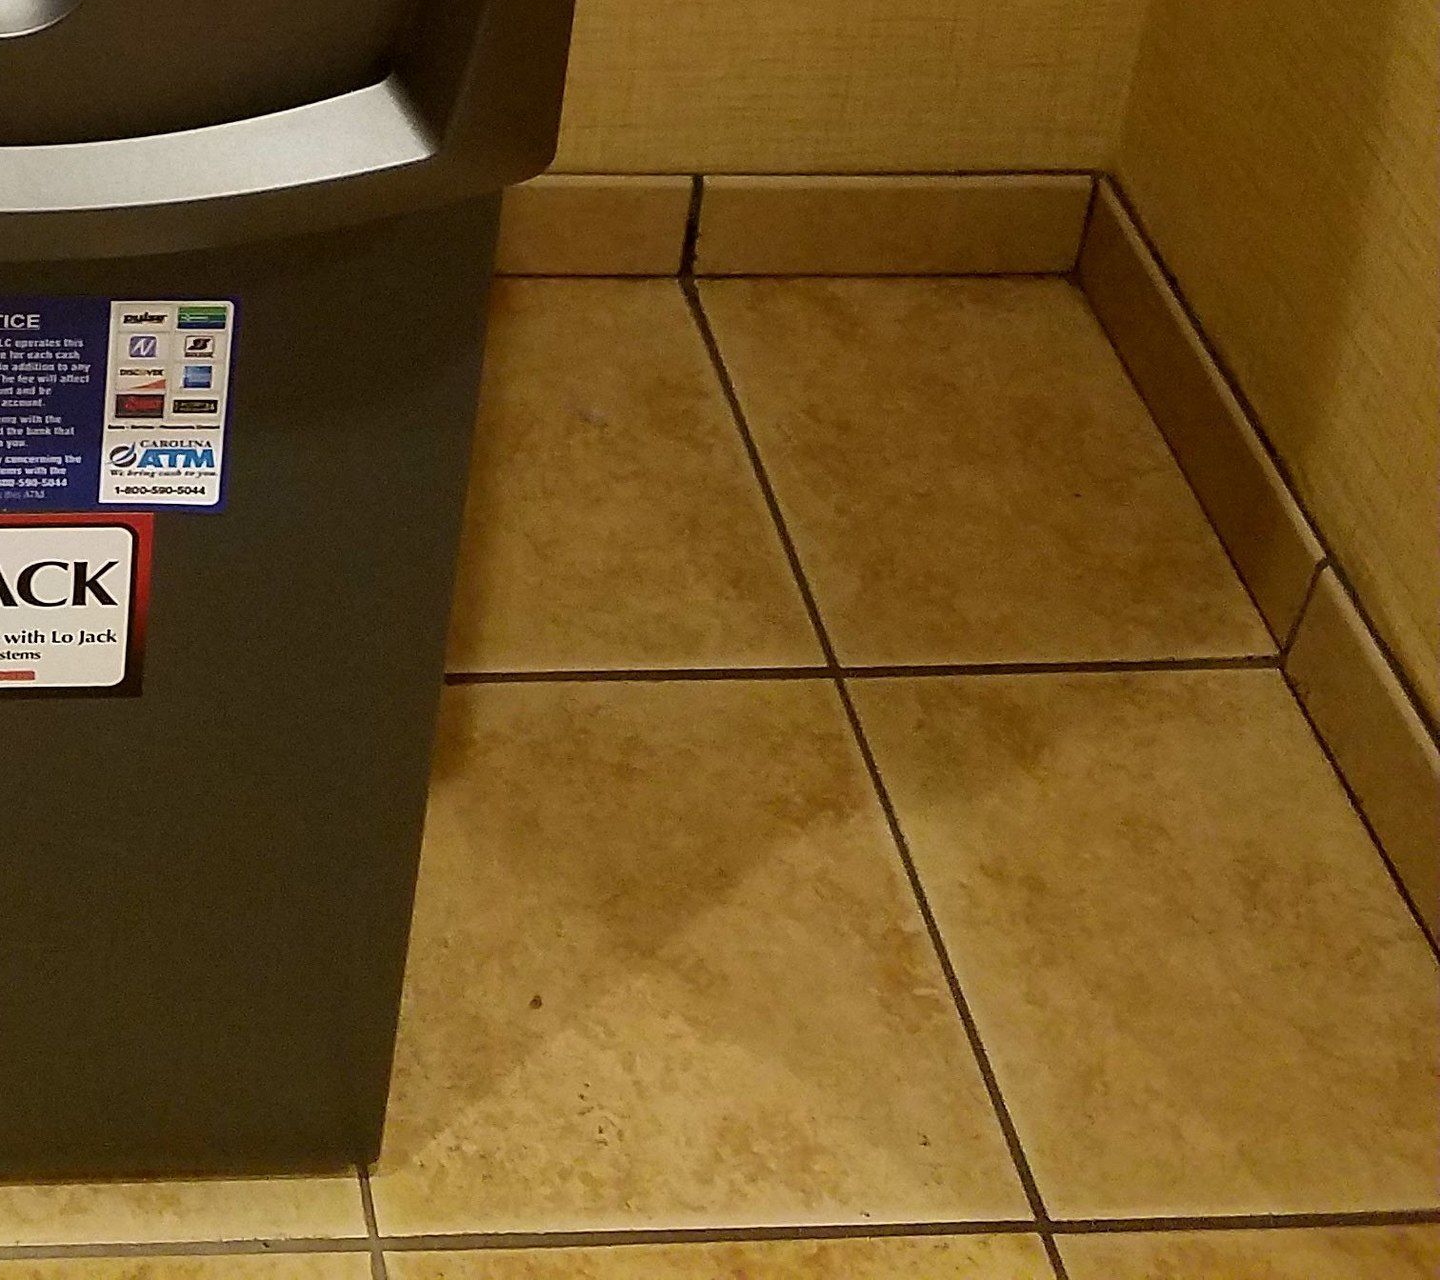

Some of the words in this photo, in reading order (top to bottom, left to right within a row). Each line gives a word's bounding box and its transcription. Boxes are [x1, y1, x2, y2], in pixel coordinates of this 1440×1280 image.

[15, 339, 61, 349] operates
[63, 339, 84, 348] this
[140, 439, 212, 448] CAROLINA
[4, 455, 62, 465] concerning
[64, 455, 82, 464] the
[137, 448, 215, 468] ATM
[25, 467, 47, 475] with
[49, 467, 66, 475] the
[115, 485, 206, 495] 1-800-590-5044
[4, 630, 45, 644] with
[51, 630, 73, 644] Lo
[78, 629, 117, 645] Jack
